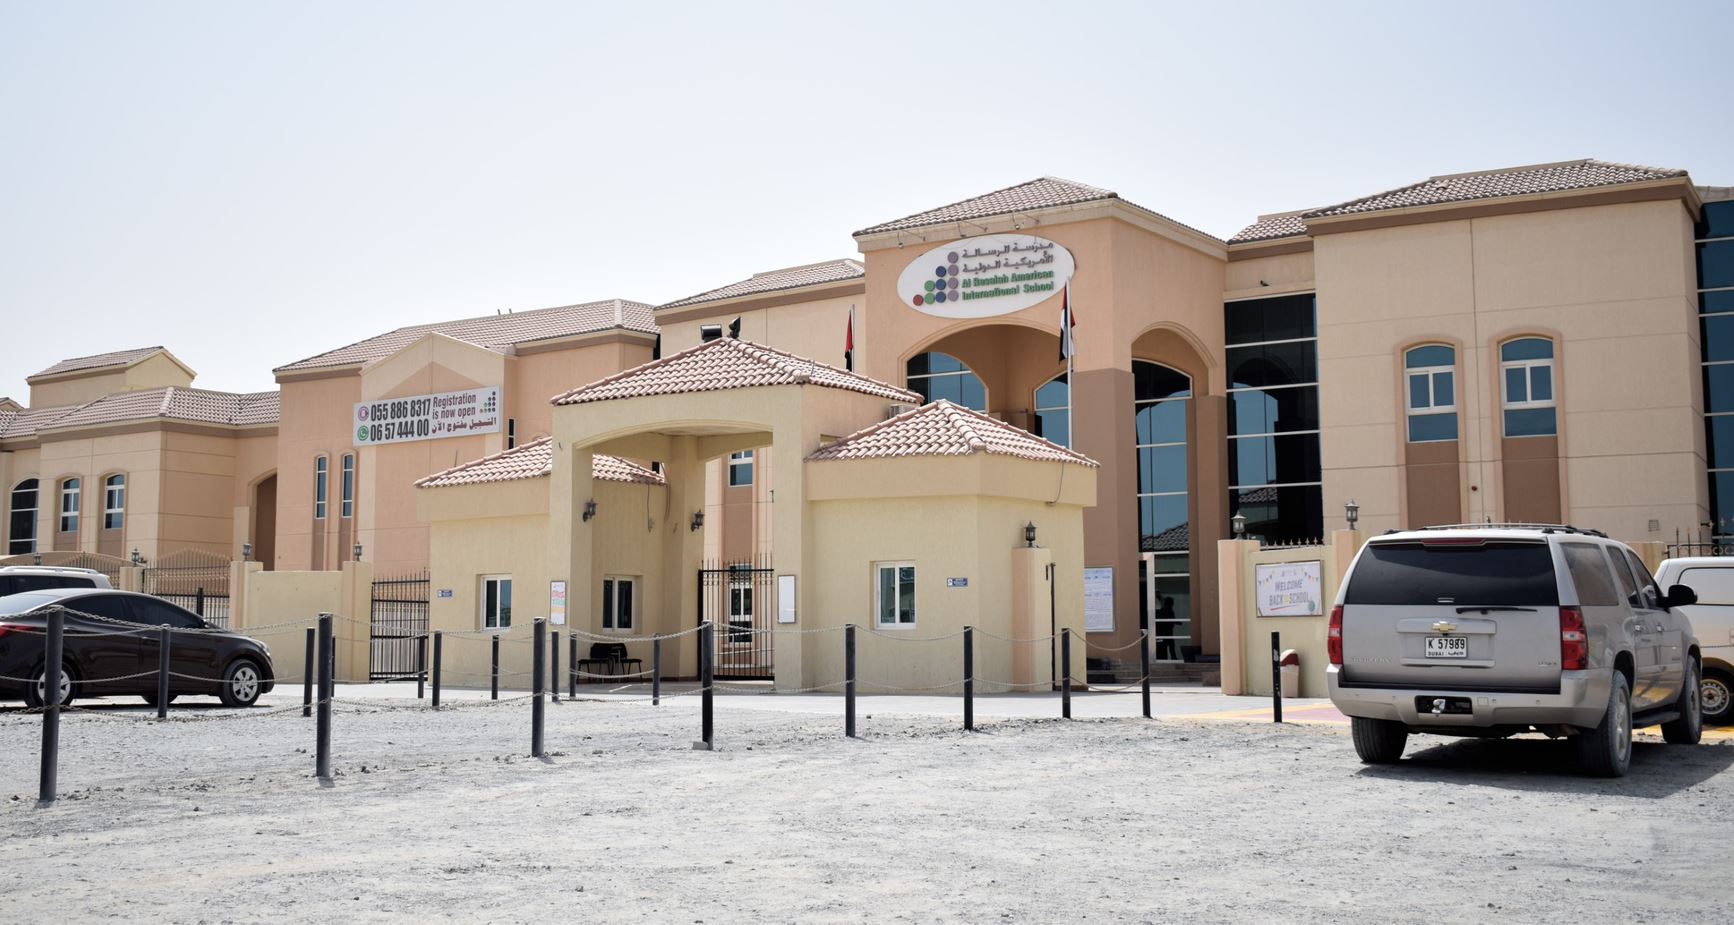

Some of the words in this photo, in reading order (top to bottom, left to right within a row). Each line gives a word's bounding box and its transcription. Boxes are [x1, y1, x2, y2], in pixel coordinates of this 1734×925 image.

[961, 244, 1010, 259] الرسالة
[1012, 242, 1054, 253] مدرسة
[962, 279, 972, 288] Al
[1011, 270, 1054, 282] American
[962, 286, 1020, 300] International
[1023, 281, 1054, 293] School
[433, 394, 476, 409] Registration
[370, 403, 388, 421] 055
[390, 401, 408, 419] 886
[410, 399, 431, 418] 8317
[432, 411, 439, 420] is
[441, 409, 456, 419] now
[457, 406, 476, 419] open
[370, 424, 382, 441] 06
[385, 422, 395, 440] 57
[397, 420, 414, 438] 444
[416, 418, 429, 436] 00
[447, 421, 468, 432] مفتوح
[469, 417, 497, 430] التسجيل
[1275, 579, 1303, 592] WELCOME
[1269, 594, 1283, 606] BACK
[1289, 592, 1309, 604] SCHOOL
[1428, 639, 1434, 649] K
[1438, 638, 1465, 649] 57989
